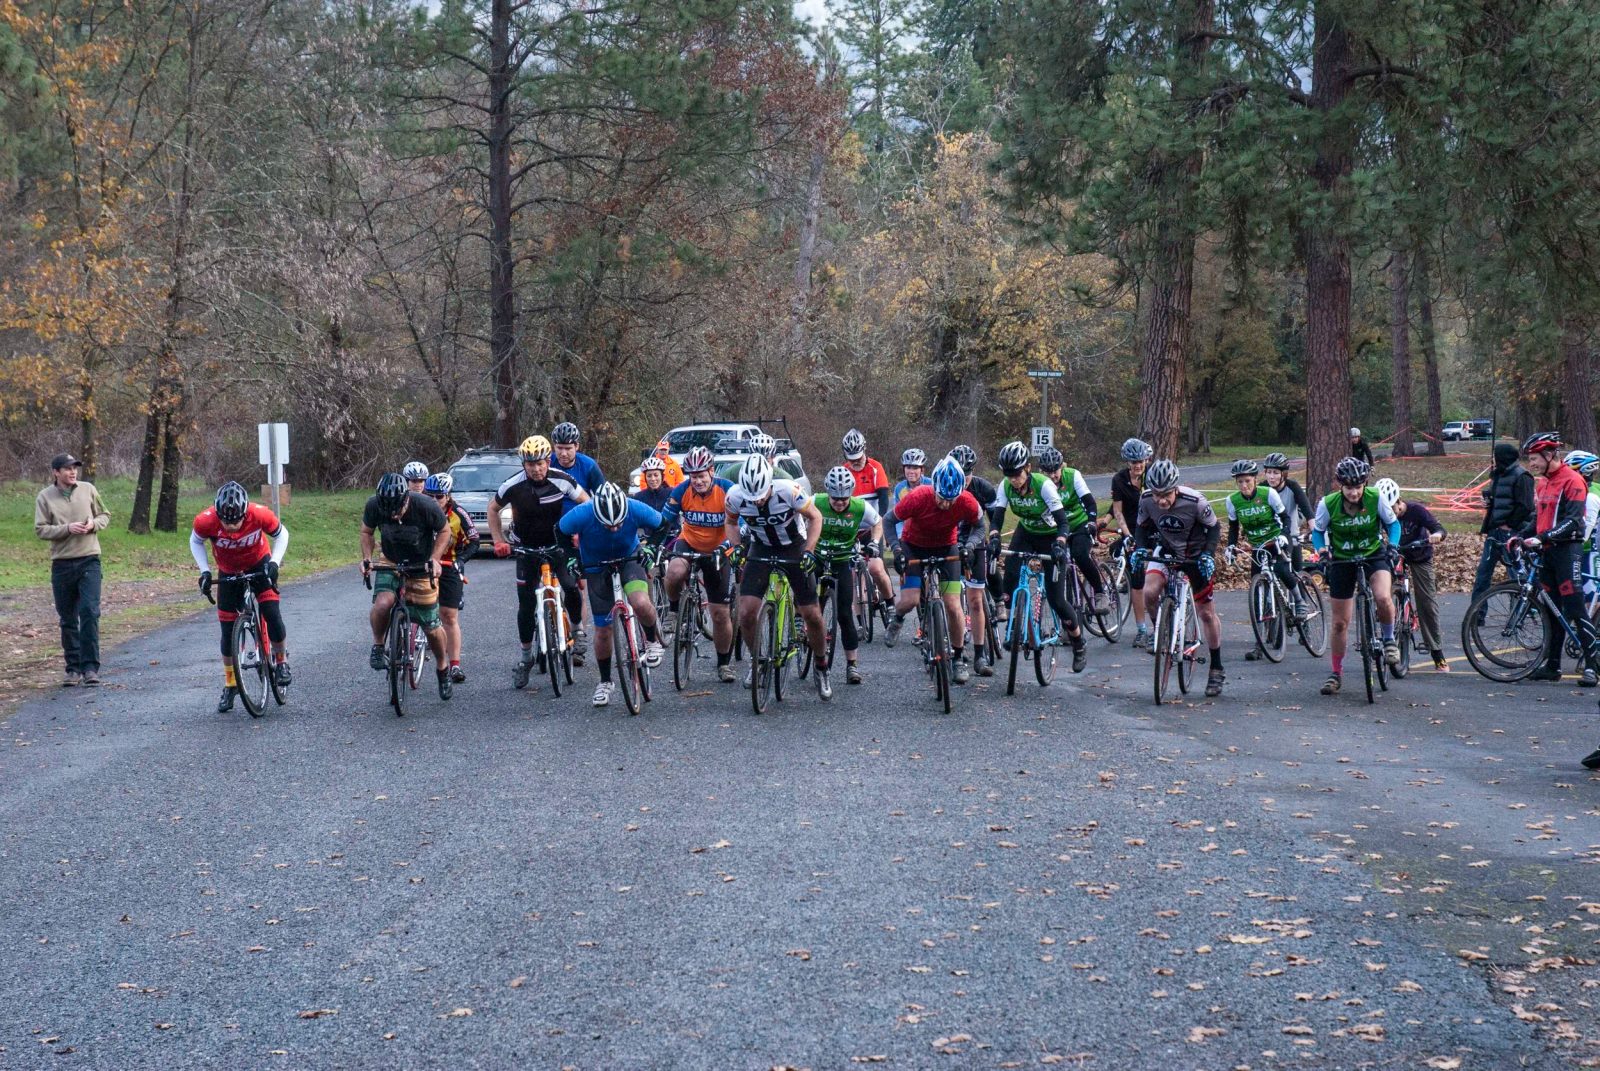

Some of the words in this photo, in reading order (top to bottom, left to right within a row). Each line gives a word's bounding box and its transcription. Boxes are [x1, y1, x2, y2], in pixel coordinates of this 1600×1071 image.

[1036, 434, 1049, 445] 15
[1010, 497, 1038, 507] TEAM
[1239, 505, 1266, 517] TEAM
[755, 512, 788, 526] SCV
[822, 516, 855, 528] TEAM
